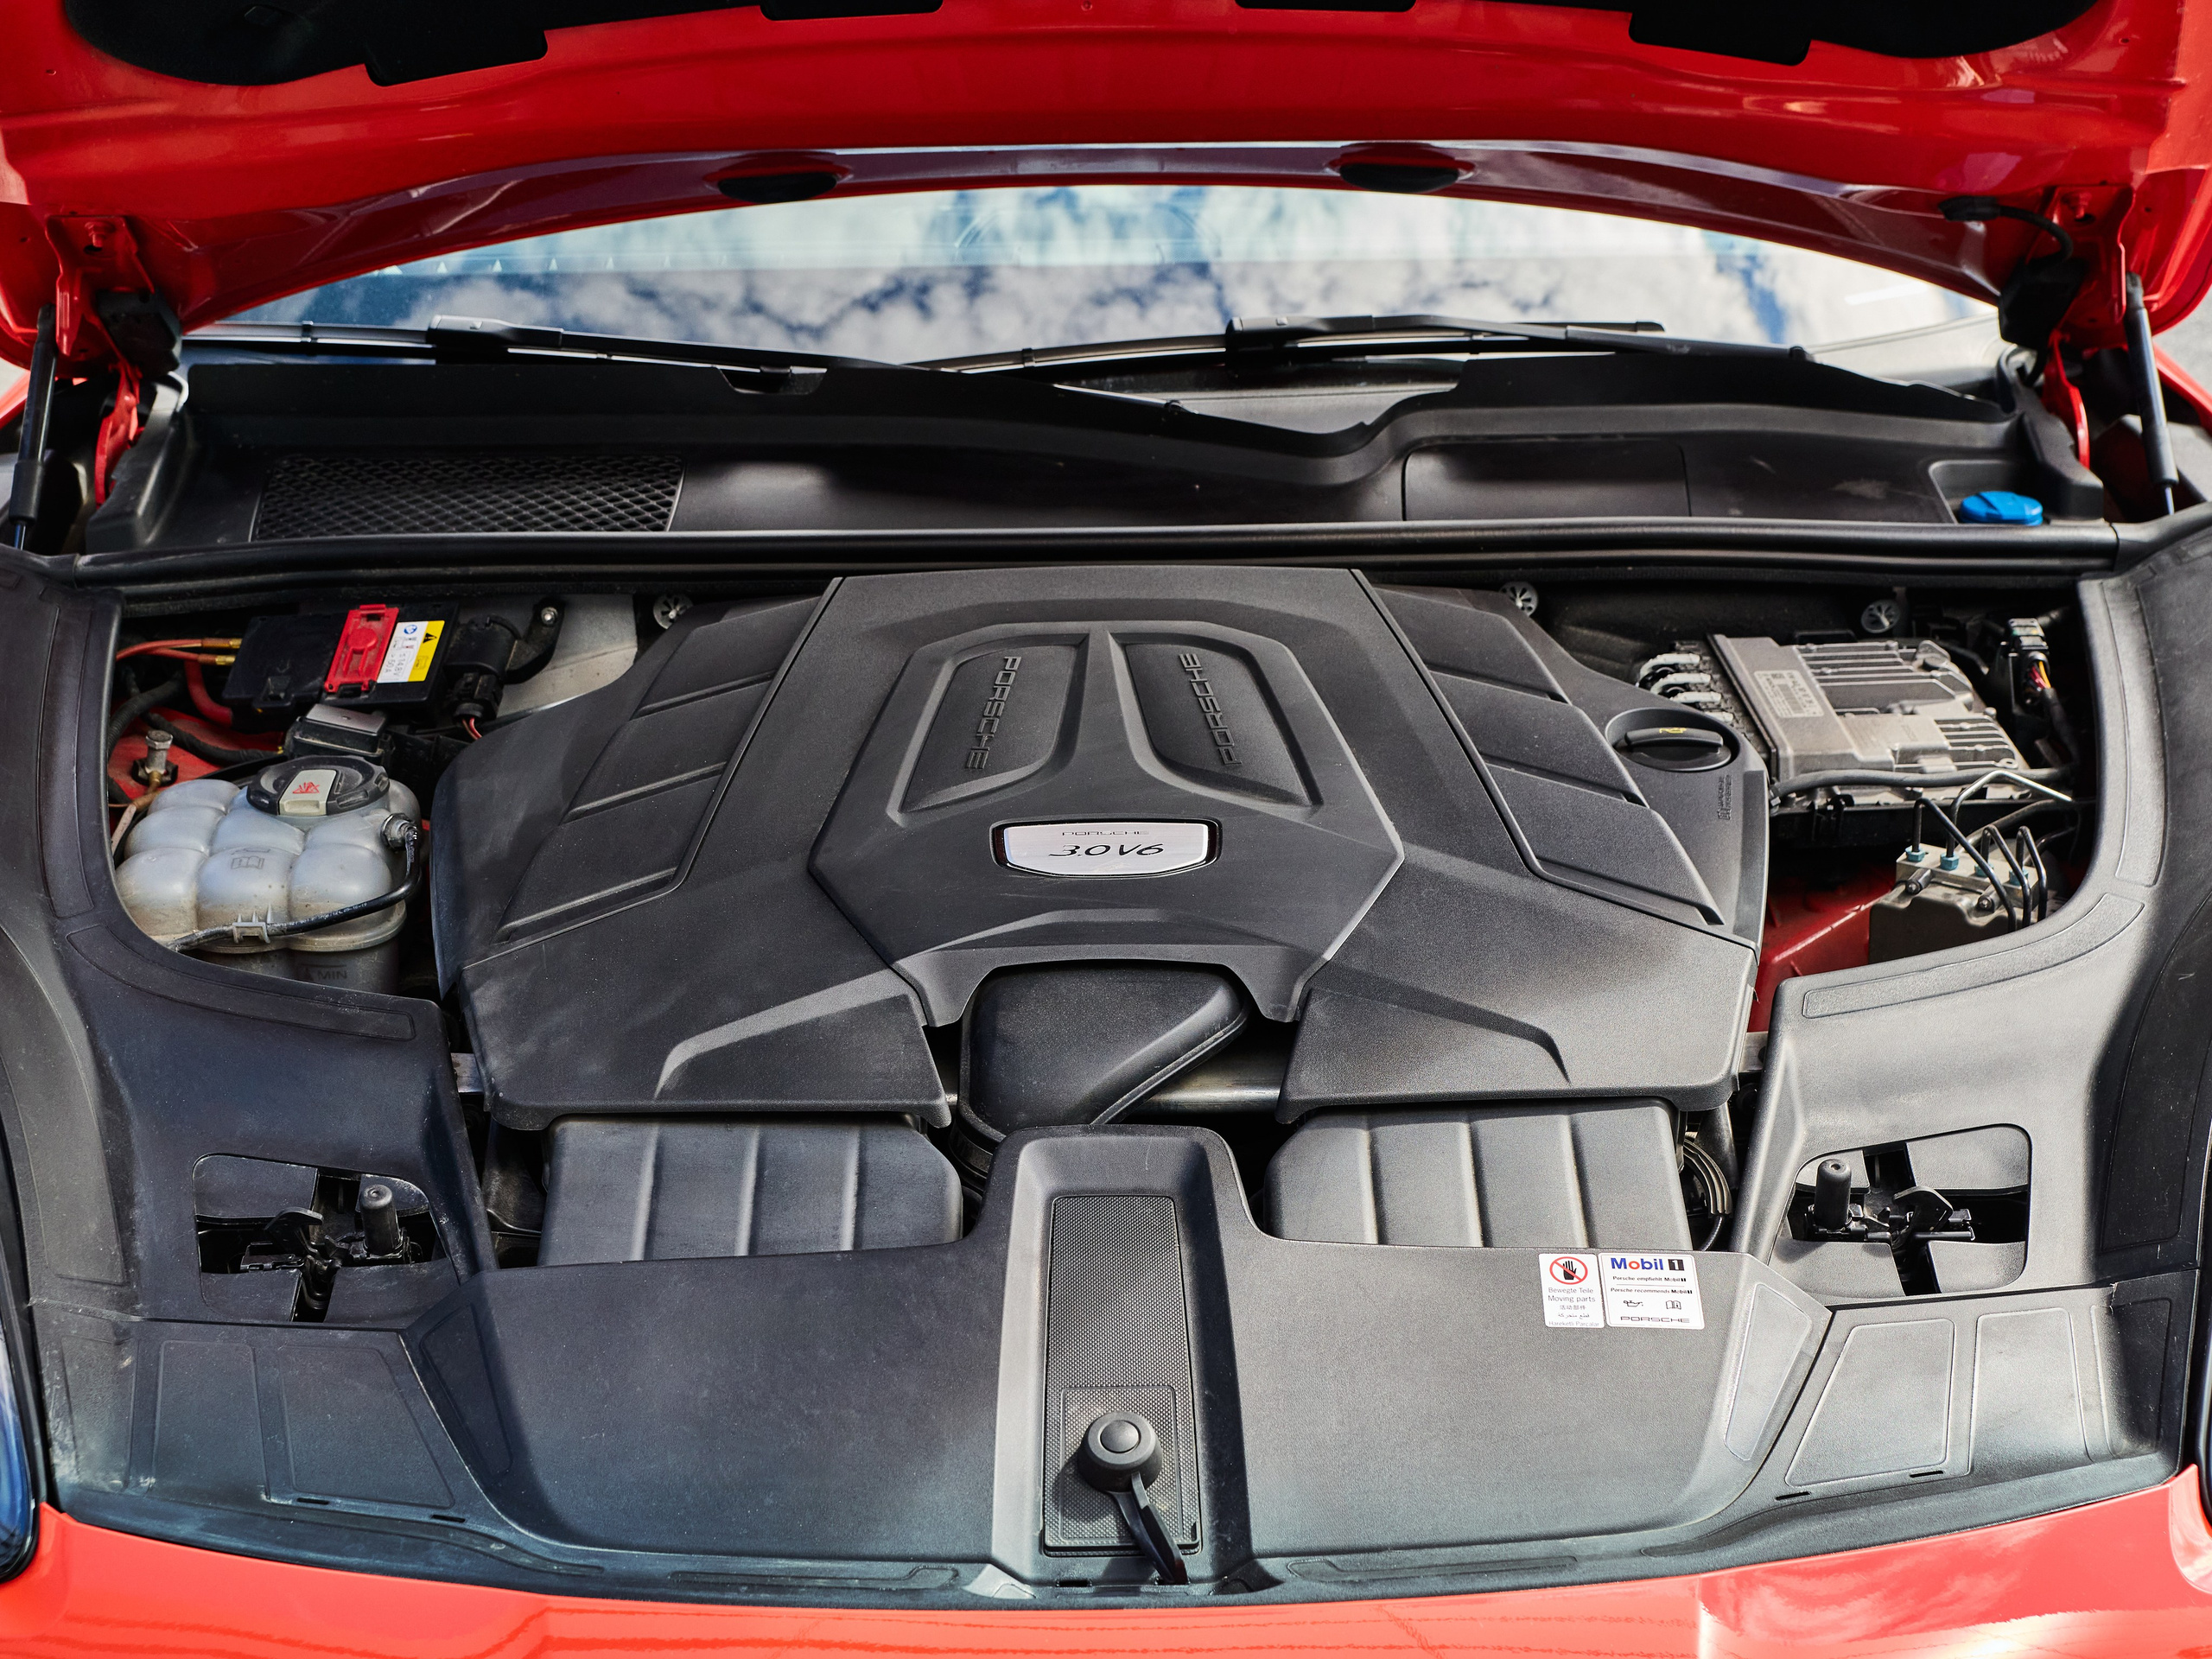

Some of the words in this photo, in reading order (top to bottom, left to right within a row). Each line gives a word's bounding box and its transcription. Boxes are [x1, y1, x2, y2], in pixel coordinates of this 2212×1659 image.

[964, 655, 1022, 770] PORSCHE
[1178, 652, 1243, 766] PORSCHE
[1048, 844, 1111, 857] 3.0
[1118, 843, 1165, 856] V6
[317, 969, 348, 981] MIN
[1610, 1257, 1664, 1271] Mobil
[1670, 1259, 1681, 1271] 1
